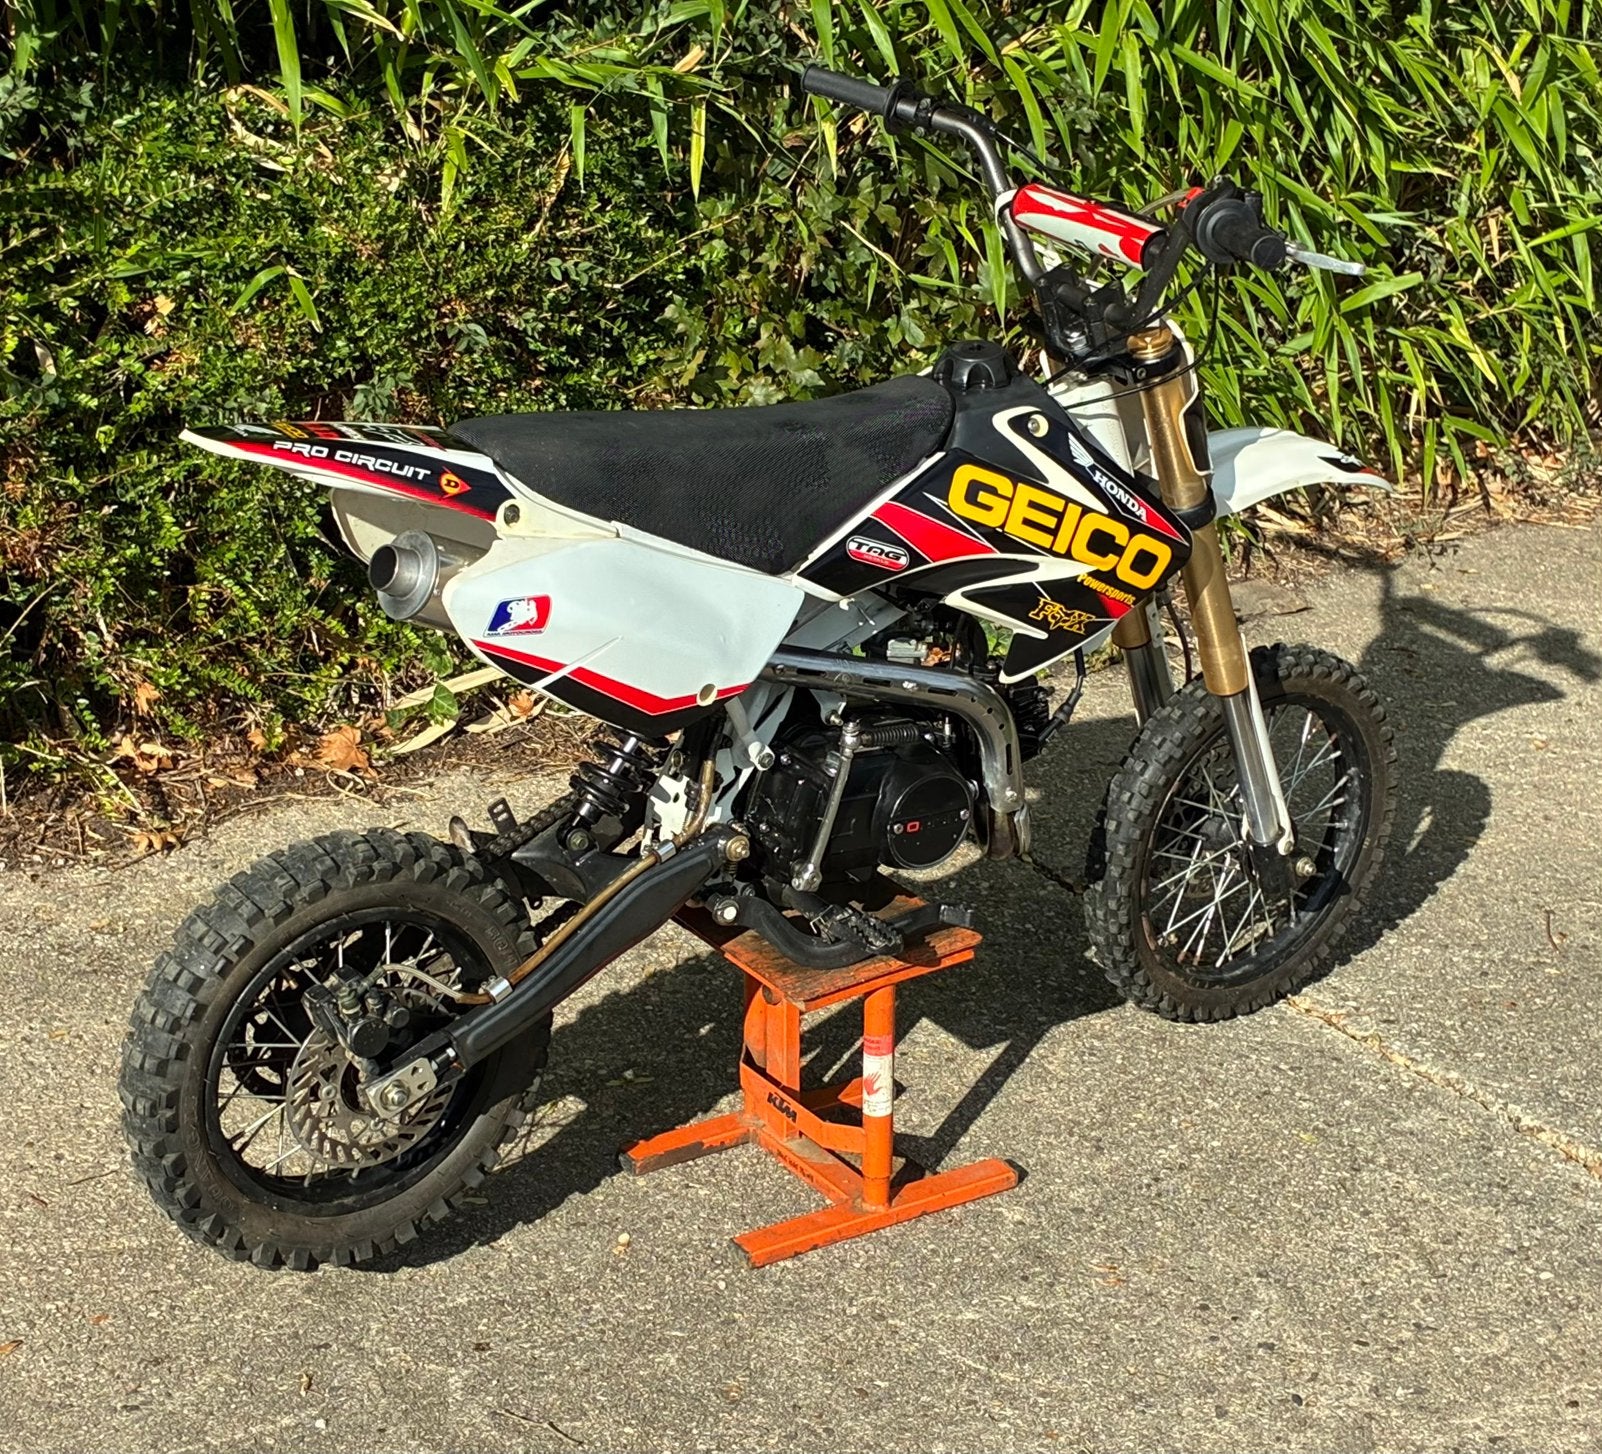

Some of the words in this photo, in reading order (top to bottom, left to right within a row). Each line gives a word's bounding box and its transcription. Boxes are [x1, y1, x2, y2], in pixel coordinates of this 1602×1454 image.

[273, 440, 329, 458] PRO
[334, 449, 431, 481] CIRCUIT
[1093, 470, 1147, 523] HONDA
[948, 463, 1172, 590] GEICO
[850, 539, 907, 562] TAG
[1077, 573, 1136, 609] Powersports
[767, 1092, 797, 1124] KTM
